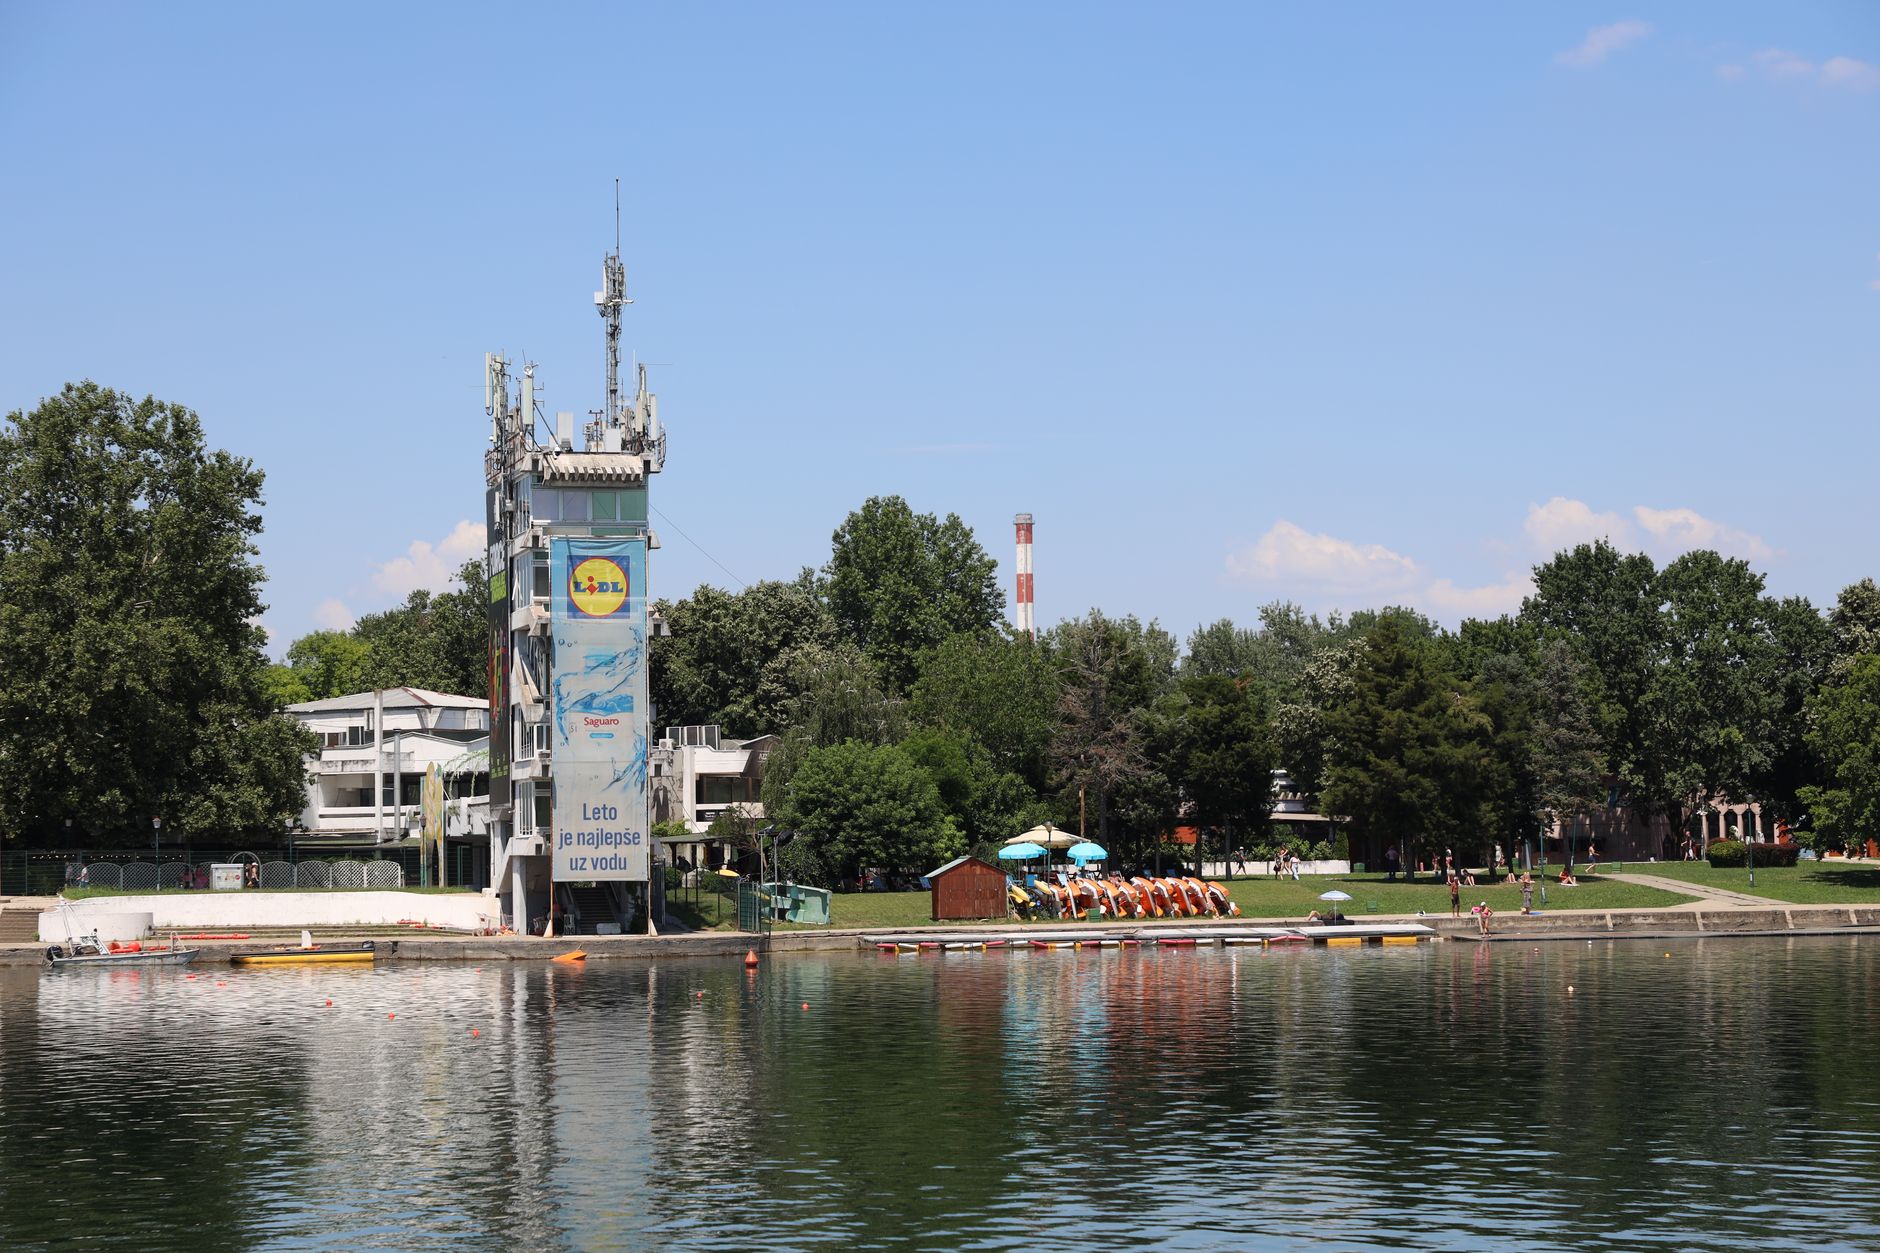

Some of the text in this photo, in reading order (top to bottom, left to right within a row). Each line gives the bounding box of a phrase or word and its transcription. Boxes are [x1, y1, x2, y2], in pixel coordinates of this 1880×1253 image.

[583, 716, 620, 728] Saguaro
[583, 803, 618, 821] Leto
[558, 827, 641, 850] je najlepše
[569, 853, 627, 871] uz vodu
